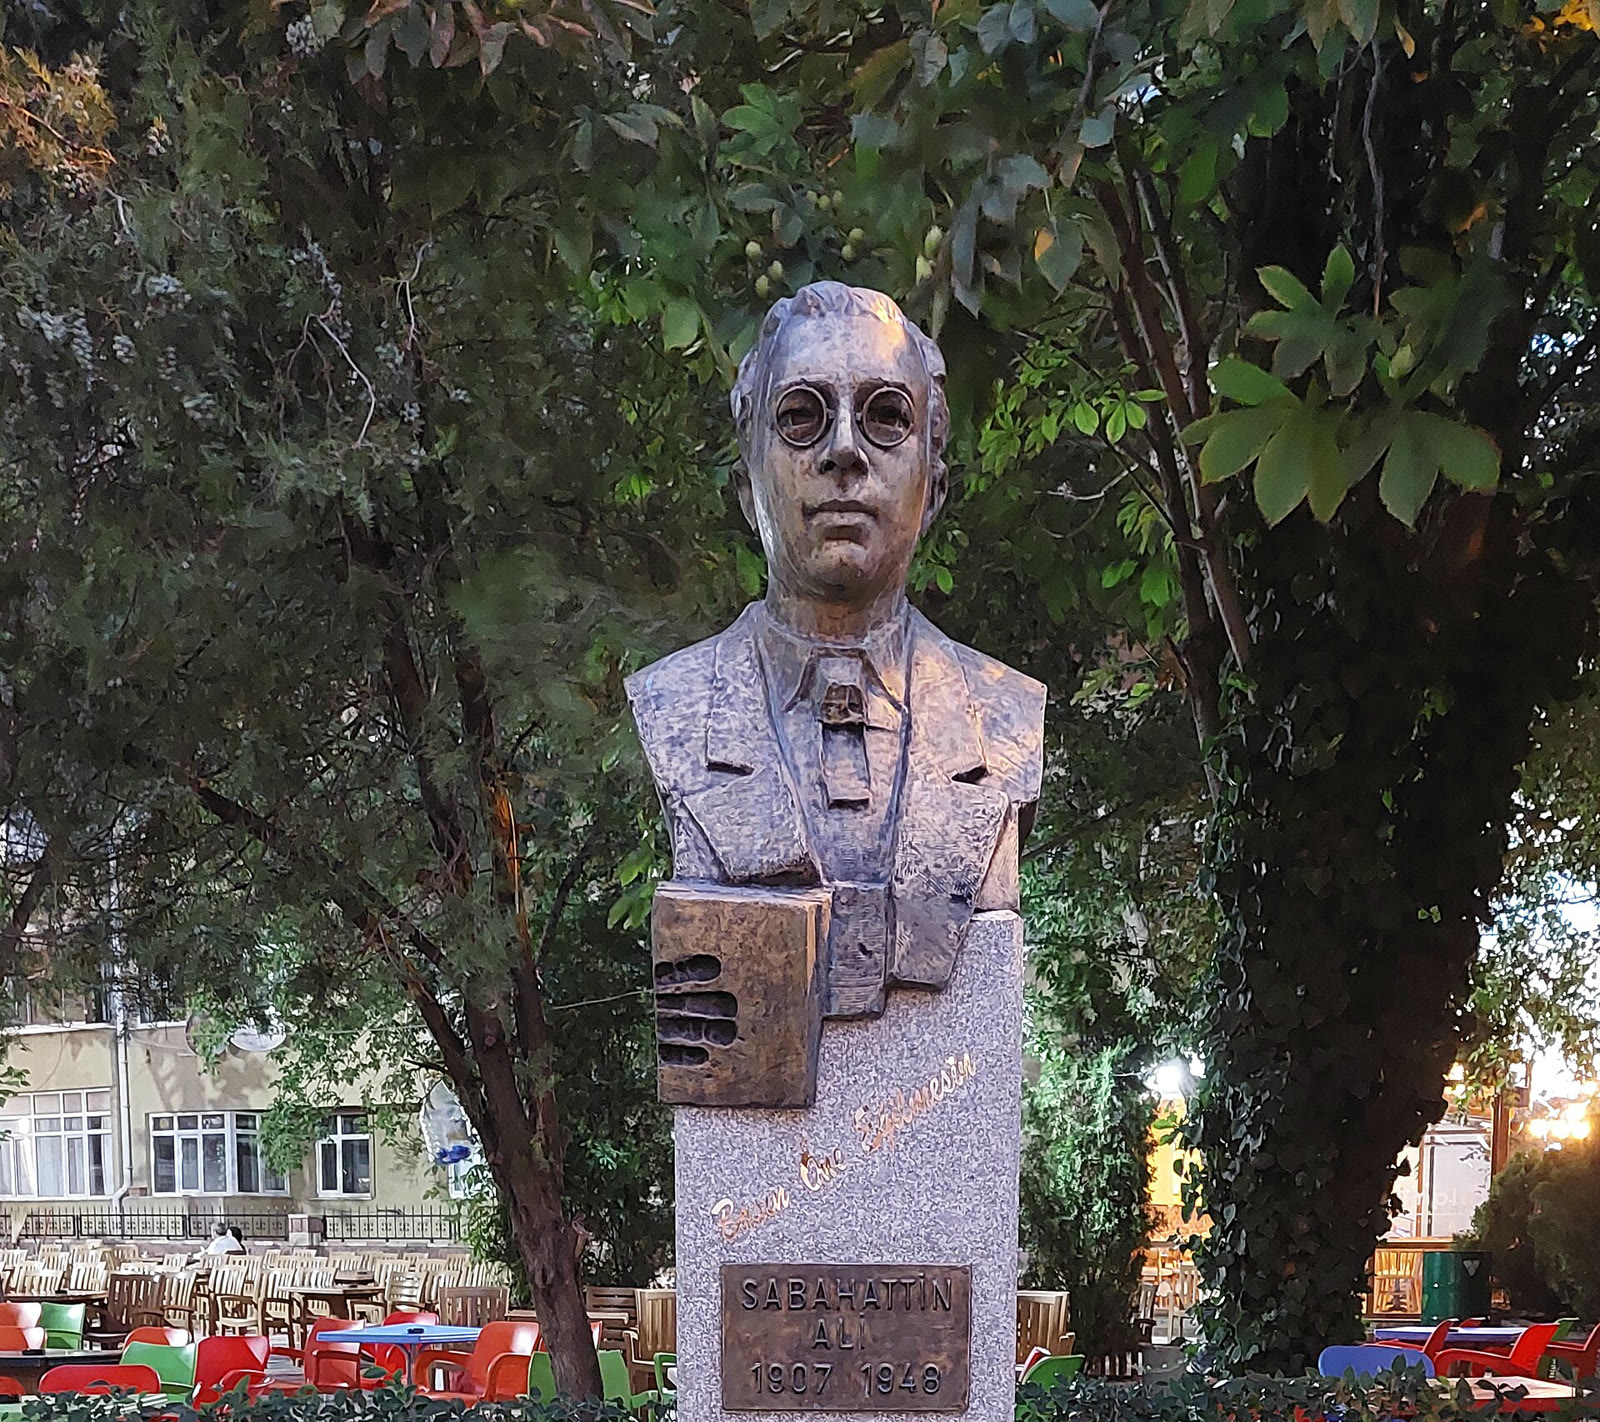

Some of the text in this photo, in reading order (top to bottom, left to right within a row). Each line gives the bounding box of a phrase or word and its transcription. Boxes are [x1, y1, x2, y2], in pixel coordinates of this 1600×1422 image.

[741, 1272, 951, 1311] SABAHATTİN
[812, 1311, 865, 1350] ALİ
[750, 1362, 941, 1398] 1907 1948
